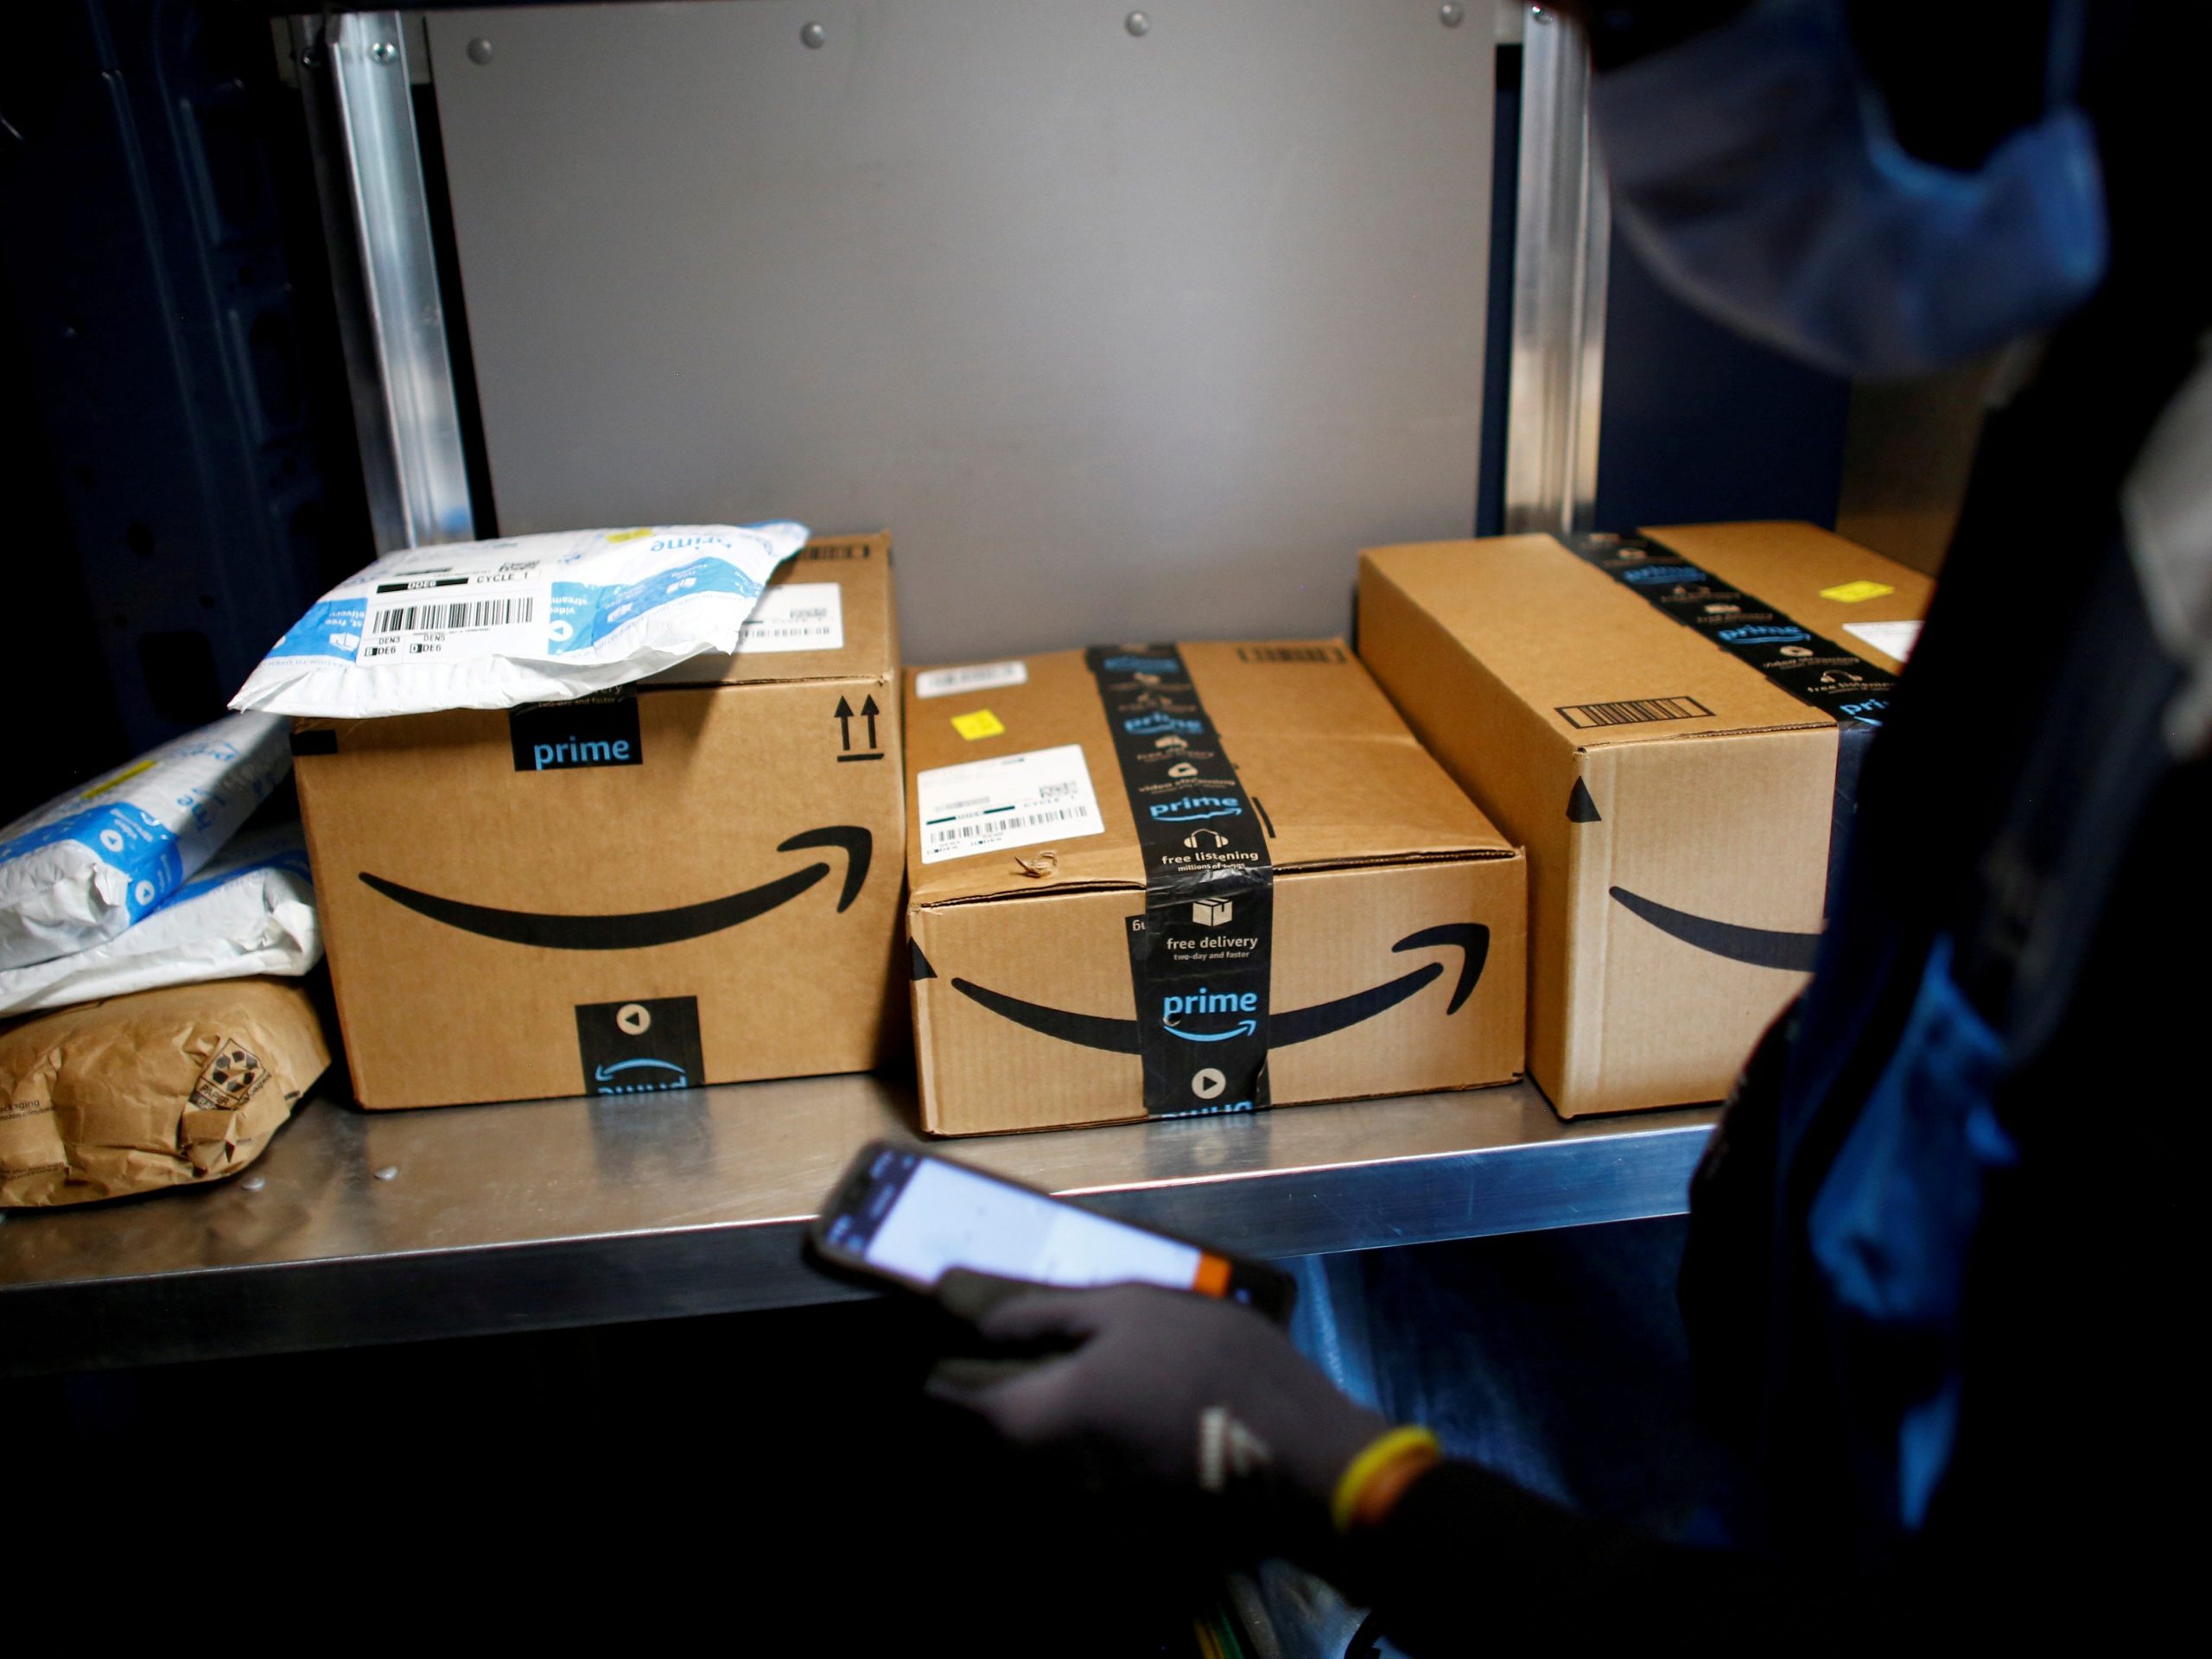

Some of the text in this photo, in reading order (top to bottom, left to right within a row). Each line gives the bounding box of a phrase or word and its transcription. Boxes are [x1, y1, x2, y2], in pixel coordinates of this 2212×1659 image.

[476, 573, 514, 583] CYCLE
[378, 636, 400, 645] DEN3
[533, 734, 631, 772] prime
[1150, 797, 1239, 817] prime
[1162, 850, 1259, 865] free listening
[1166, 936, 1258, 950] free delivery
[1163, 987, 1258, 1021] prime
